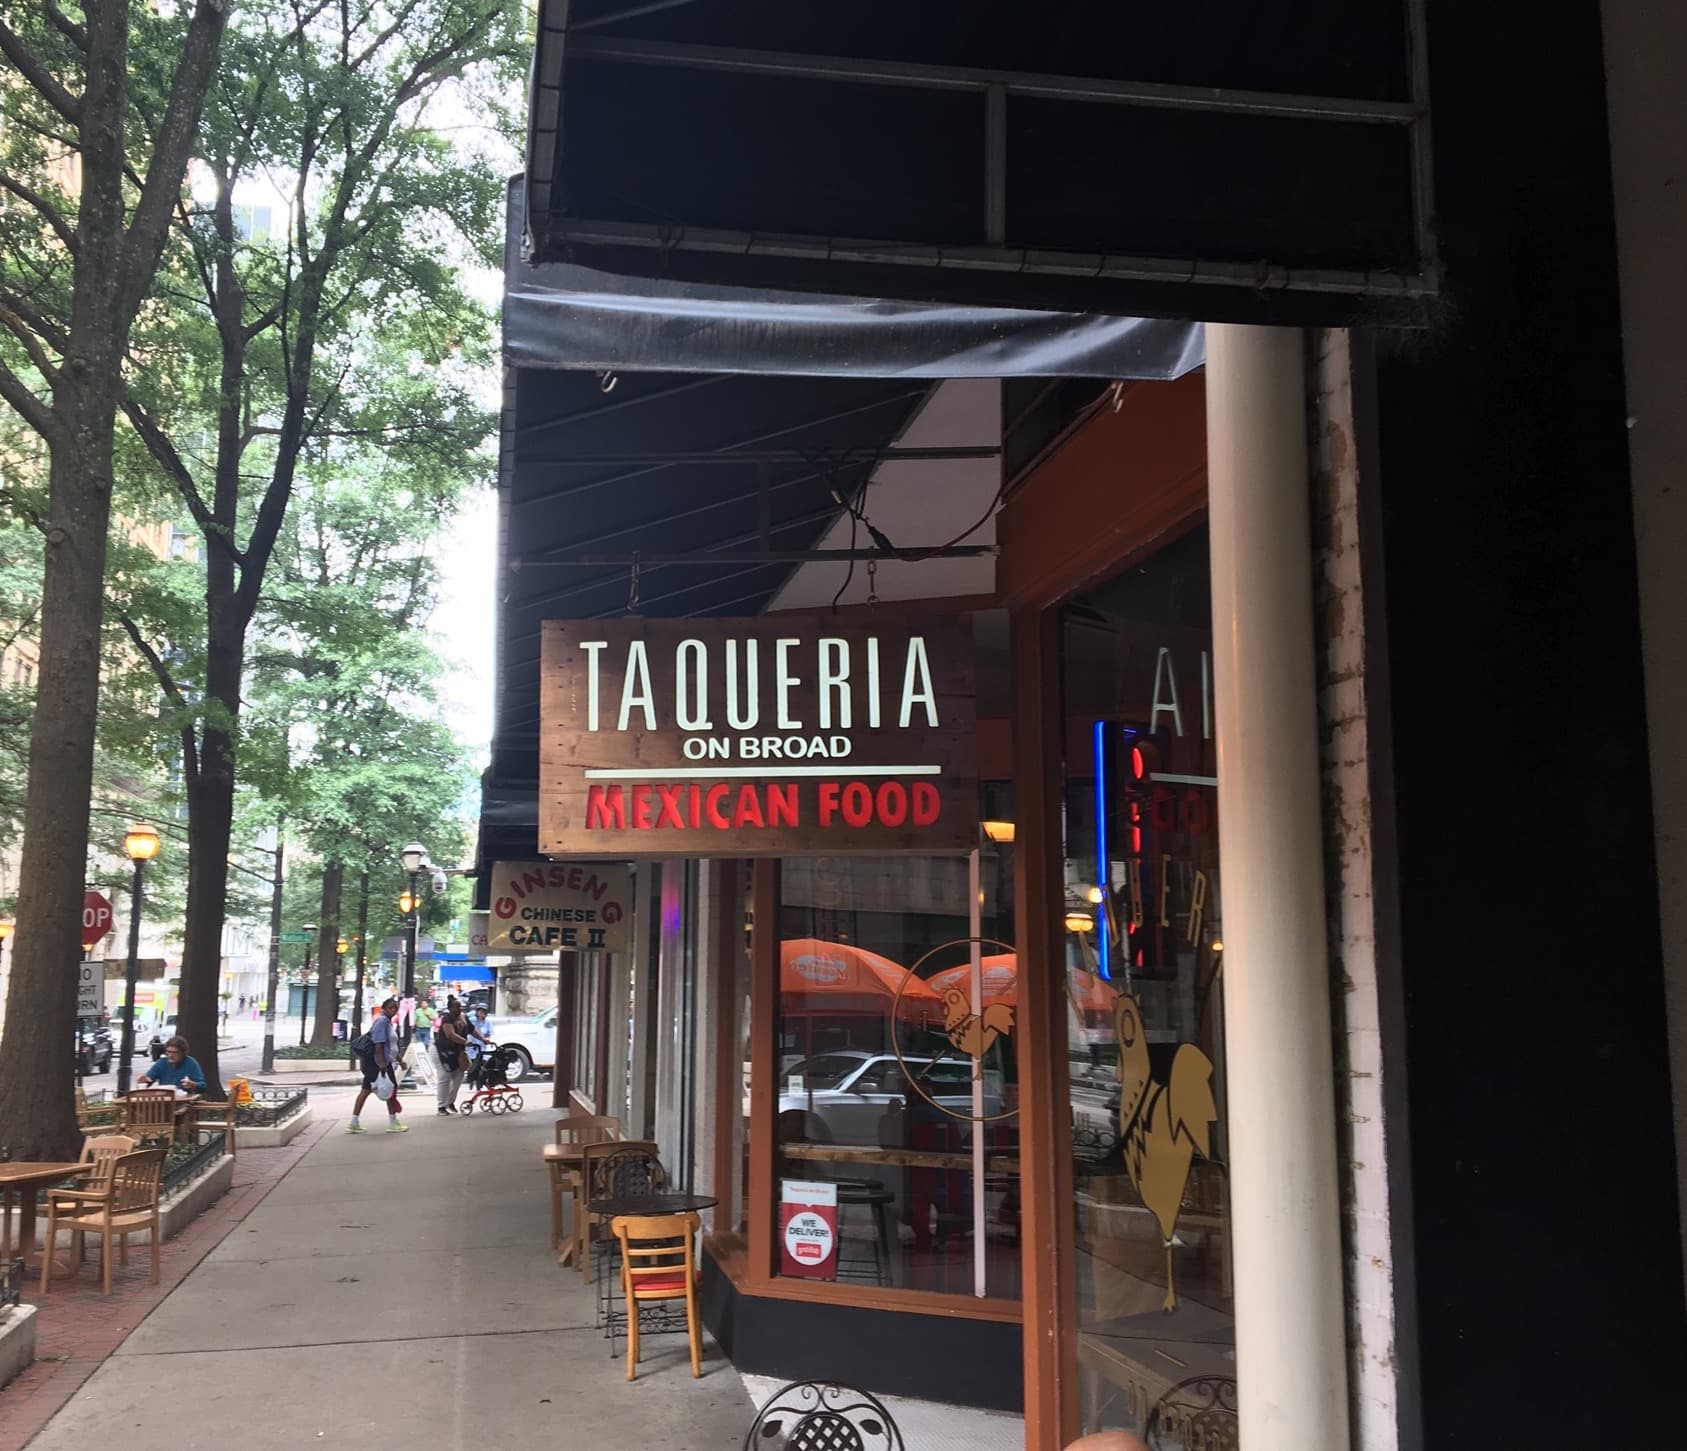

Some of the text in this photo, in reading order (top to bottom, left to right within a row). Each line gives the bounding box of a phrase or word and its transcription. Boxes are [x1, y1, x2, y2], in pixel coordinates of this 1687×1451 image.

[579, 636, 939, 732] TAQUERIA
[684, 735, 852, 759] ON BROAD
[585, 781, 941, 830] MEXICAN FOOD
[495, 865, 623, 924] GINSENG
[83, 908, 108, 928] OP
[521, 907, 596, 922] CHINESE
[509, 925, 577, 947] CAFE
[79, 984, 96, 995] GHT
[802, 1219, 816, 1227] WE
